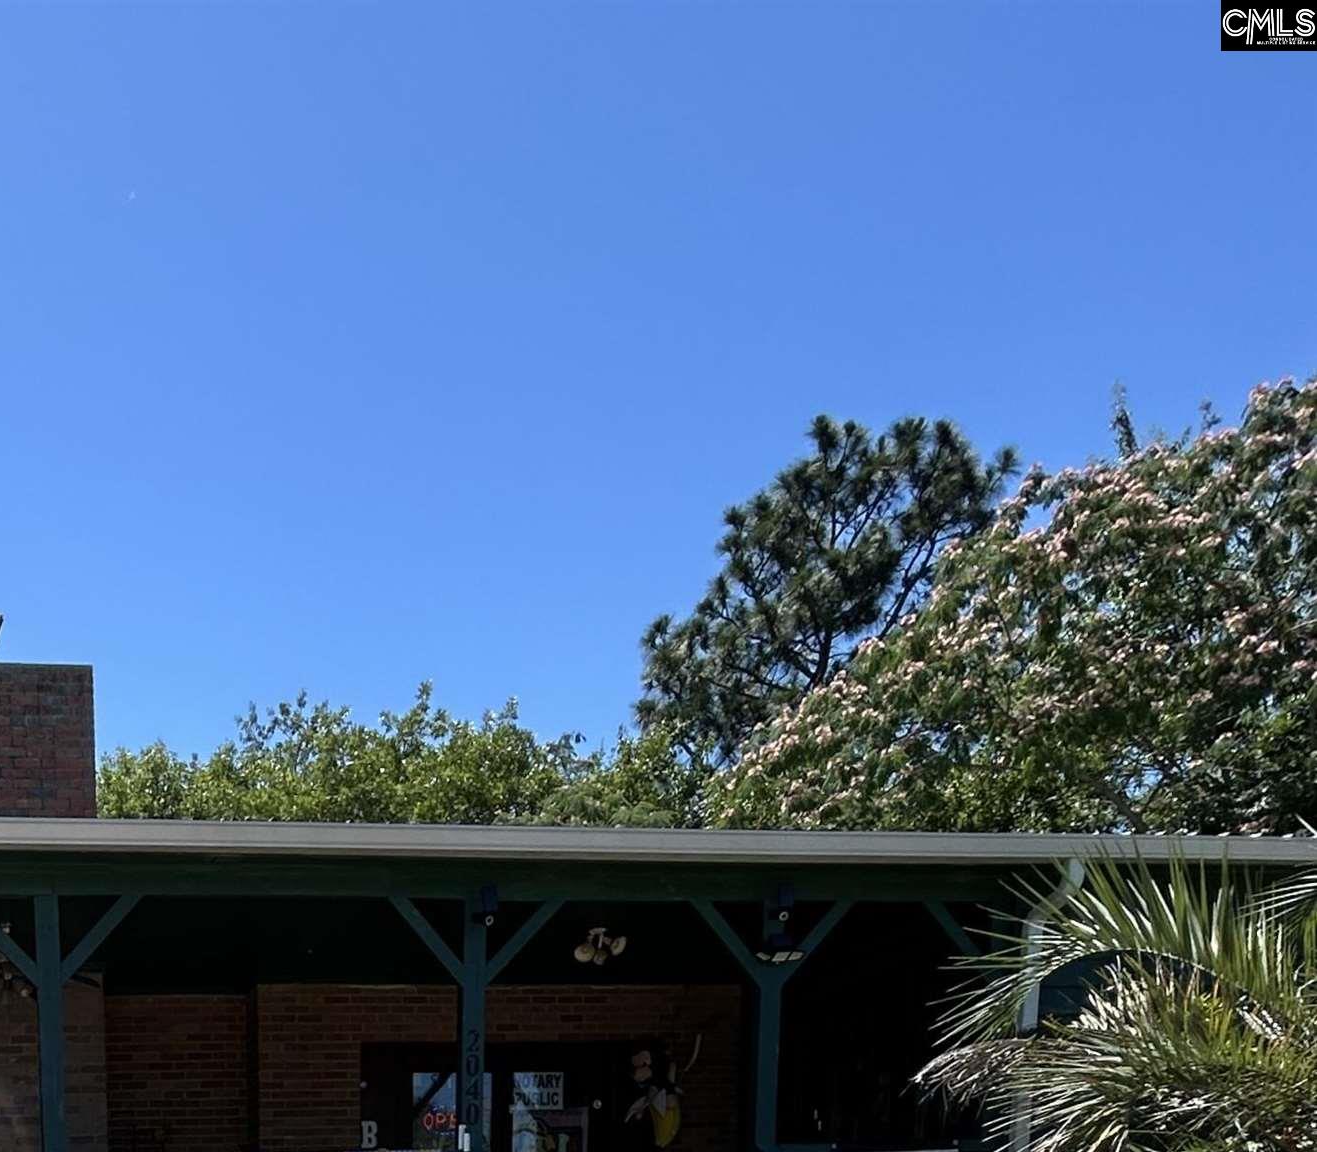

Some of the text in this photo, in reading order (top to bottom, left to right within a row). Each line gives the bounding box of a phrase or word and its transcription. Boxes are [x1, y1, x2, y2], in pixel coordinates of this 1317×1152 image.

[466, 1029, 480, 1125] 2040
[514, 1073, 562, 1088] NOTARY
[514, 1092, 559, 1105] PUBLIC
[423, 1112, 456, 1130] OPE
[361, 1120, 378, 1149] B
